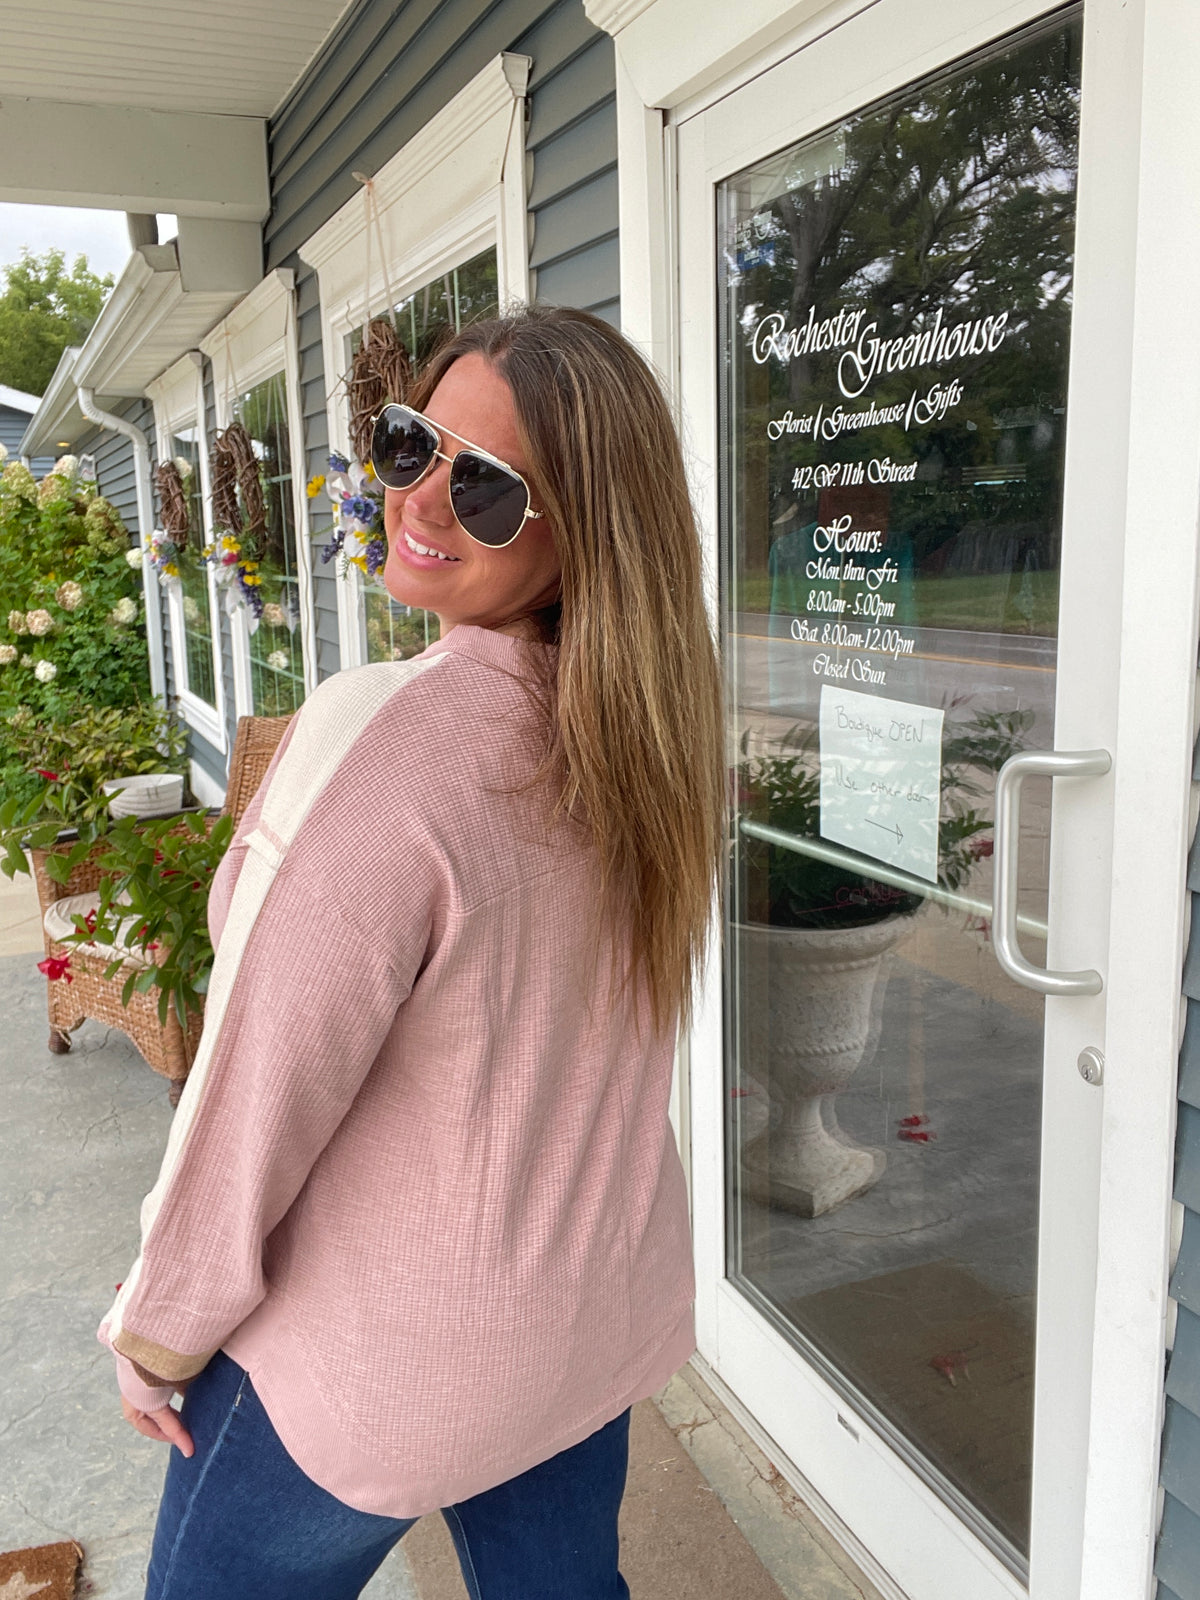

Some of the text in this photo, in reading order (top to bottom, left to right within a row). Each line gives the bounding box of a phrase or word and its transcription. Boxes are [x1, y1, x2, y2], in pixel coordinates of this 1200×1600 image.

[752, 305, 866, 364] Rochester
[837, 307, 1009, 398] Greenhouse
[914, 378, 964, 424] Gifts
[791, 466, 813, 491] 412
[840, 462, 864, 486] 11th
[867, 456, 918, 484] Street
[813, 515, 882, 553] Hours:
[843, 559, 865, 581] thru
[813, 653, 850, 679] Closed
[889, 718, 924, 743] OPEN
